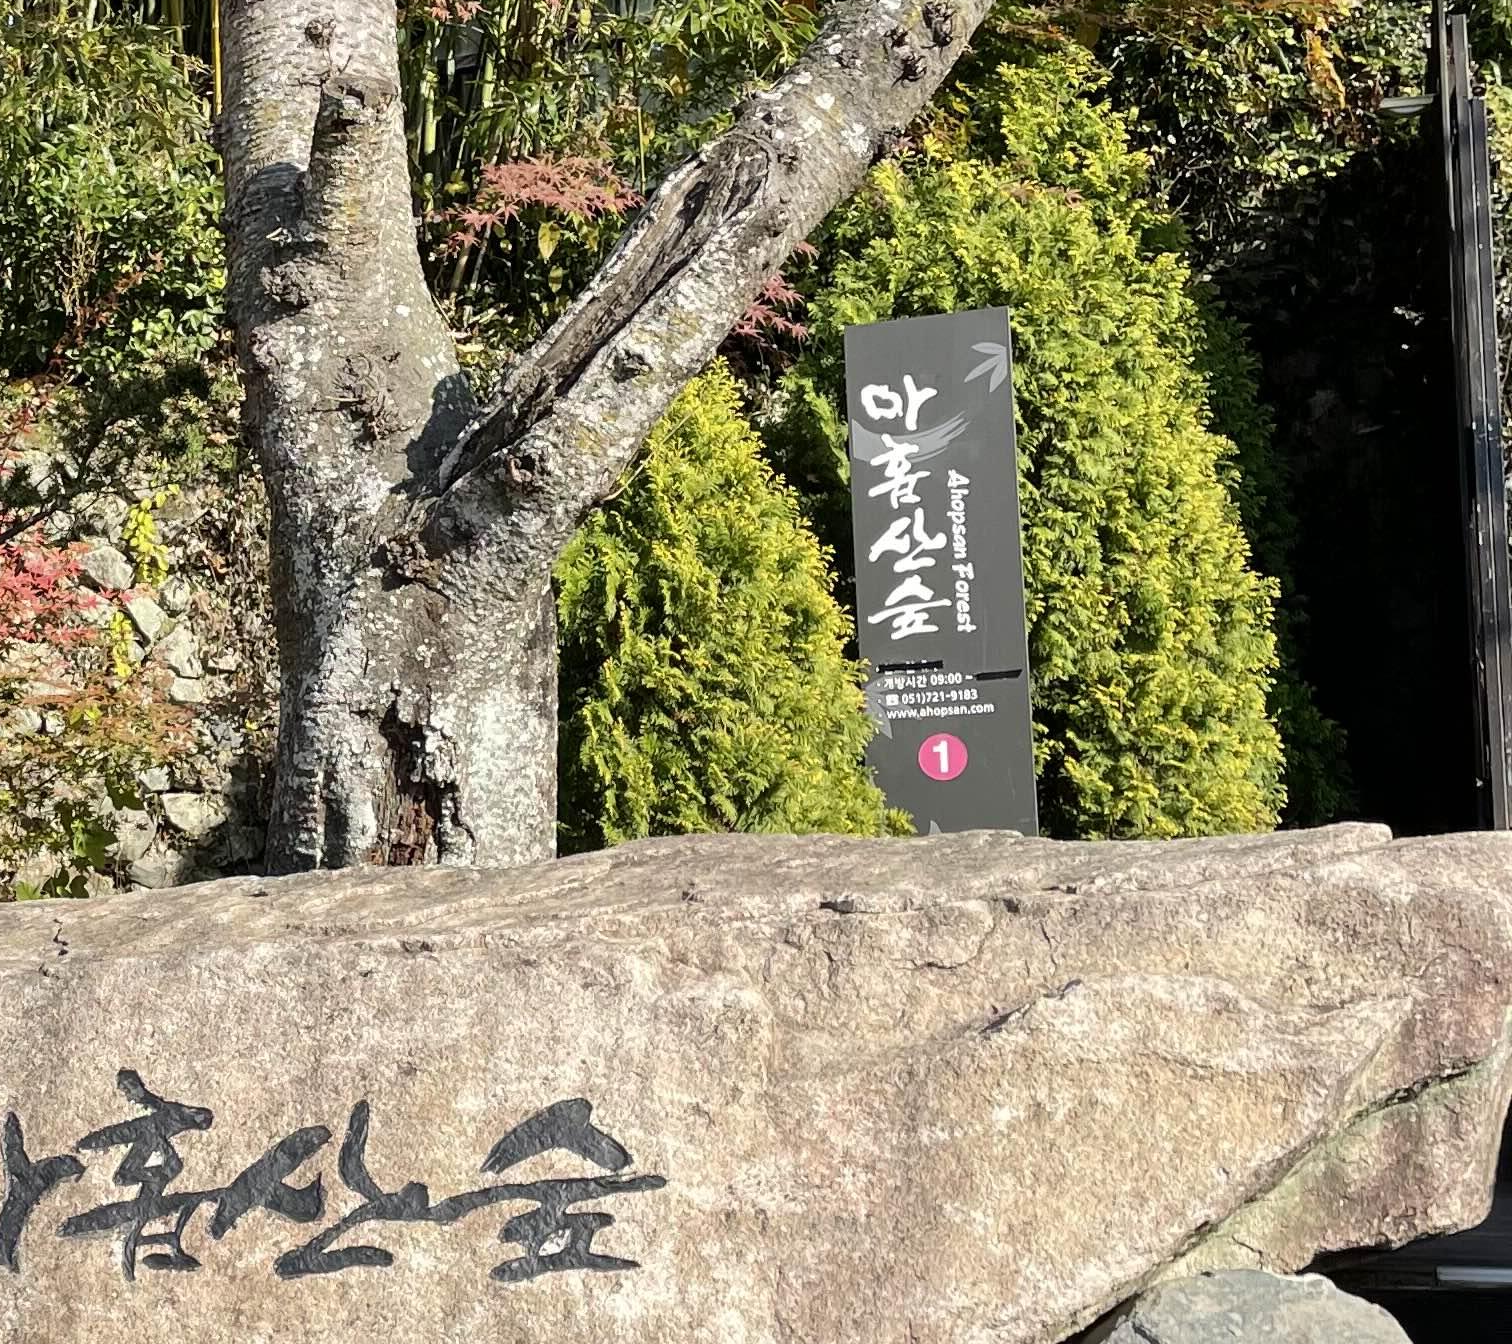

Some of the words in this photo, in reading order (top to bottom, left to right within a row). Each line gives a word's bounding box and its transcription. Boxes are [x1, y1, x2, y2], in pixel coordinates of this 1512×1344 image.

[861, 374, 952, 640] 아홉산숲
[946, 469, 970, 559] Ahopsan
[952, 562, 976, 633] Forest
[930, 673, 962, 686] 09:00
[886, 703, 995, 720] www.ahopsan.com
[901, 689, 978, 705] 051)721-9183
[932, 740, 949, 773] 1
